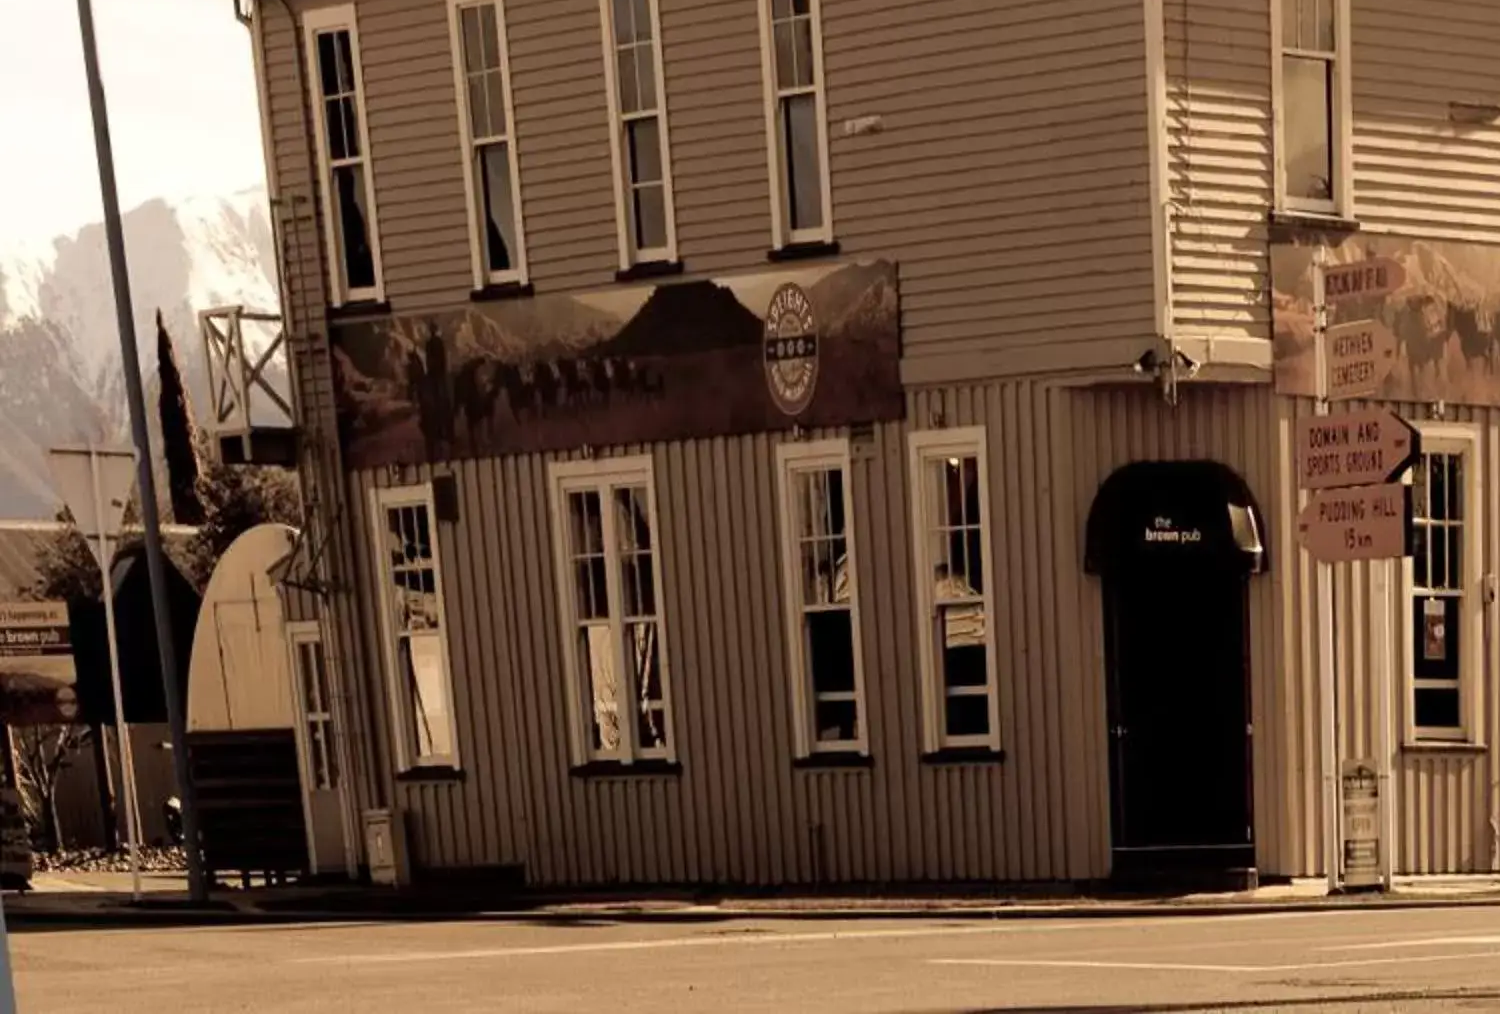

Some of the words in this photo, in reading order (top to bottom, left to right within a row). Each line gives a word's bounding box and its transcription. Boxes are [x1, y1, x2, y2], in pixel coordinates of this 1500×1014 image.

[1309, 425, 1349, 448] DOMAIN
[1357, 421, 1379, 443] AND
[1306, 453, 1340, 477] SPORTS
[1346, 449, 1382, 473] GROUND
[1320, 498, 1365, 522] PUDDING
[1372, 496, 1397, 518] HILL
[1155, 516, 1172, 529] the
[1145, 527, 1179, 542] brown
[1181, 528, 1201, 545] pub
